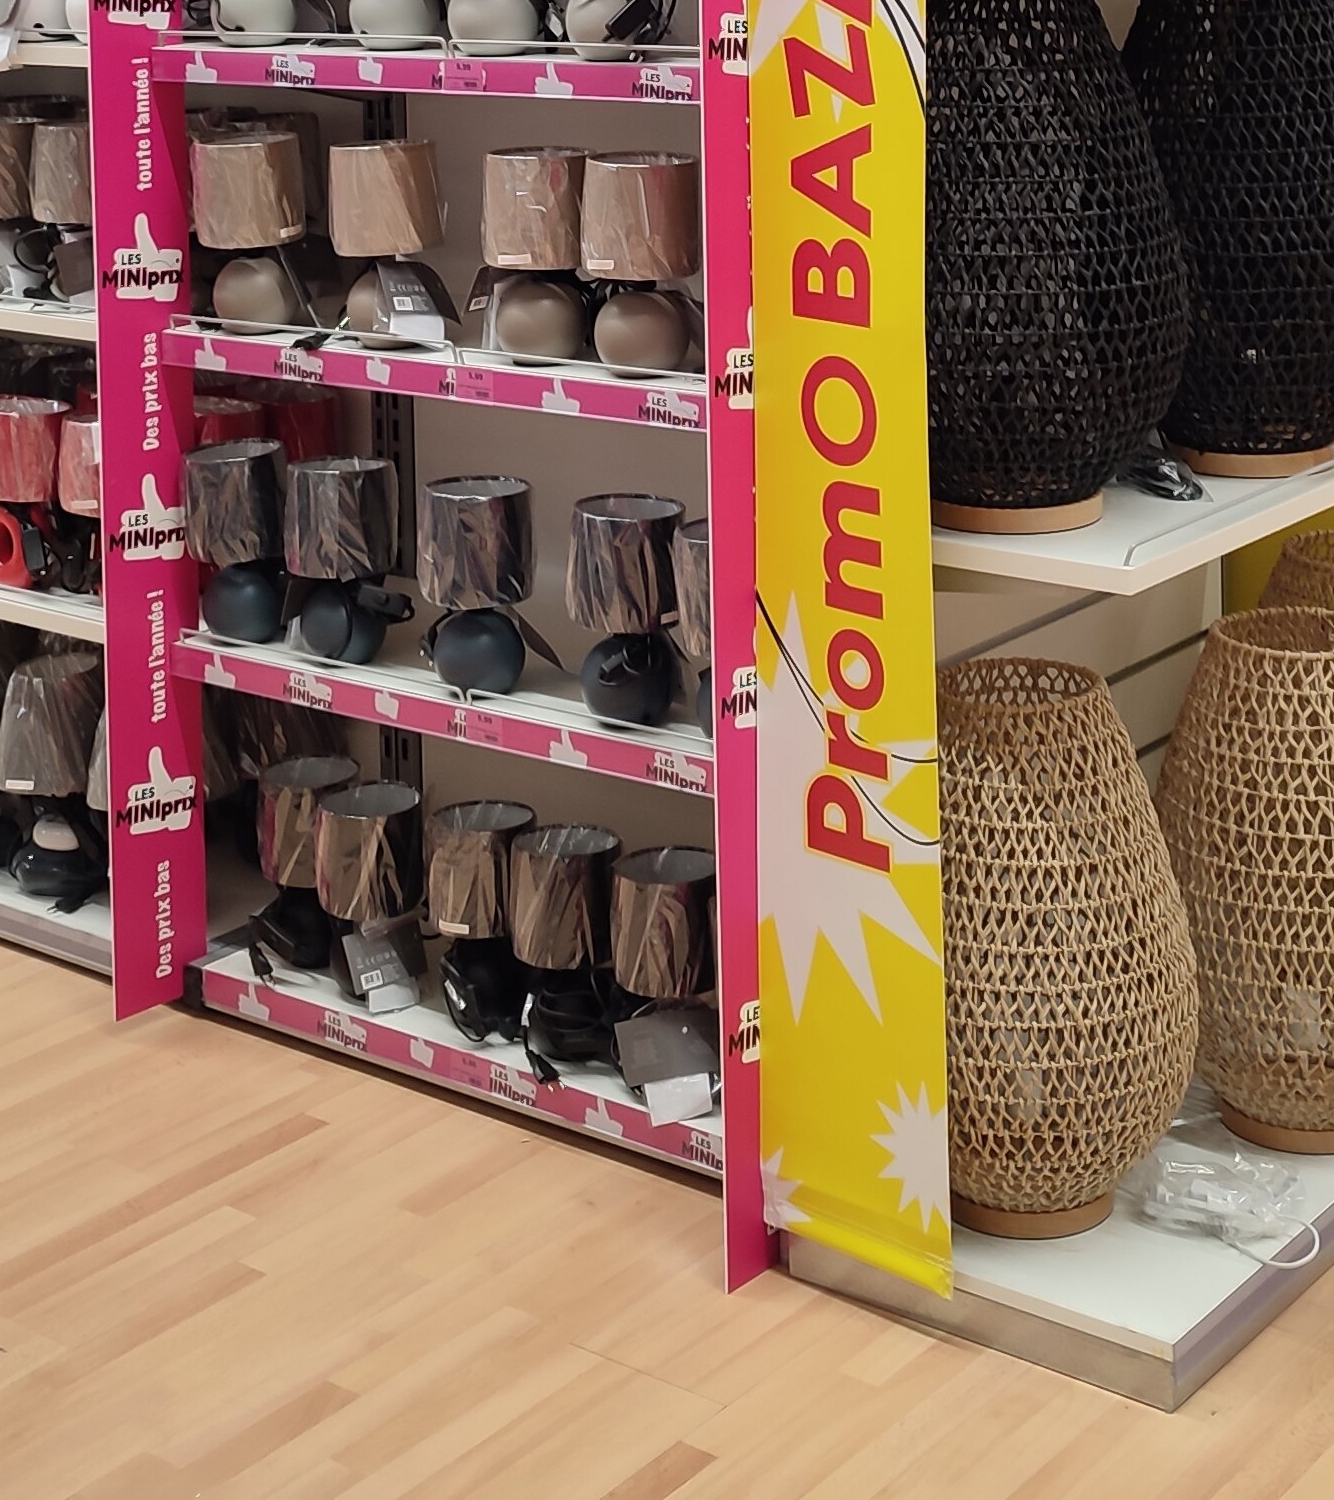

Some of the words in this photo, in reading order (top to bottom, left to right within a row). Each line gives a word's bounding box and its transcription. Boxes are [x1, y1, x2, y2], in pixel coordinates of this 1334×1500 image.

[136, 136, 153, 191] toute
[121, 252, 142, 266] LES
[141, 332, 157, 366] bas
[141, 370, 163, 414] prix
[143, 417, 160, 451] Des
[128, 513, 149, 528] LES
[150, 673, 167, 723] toute
[134, 785, 156, 802] LES
[152, 860, 170, 894] bas
[154, 896, 177, 935] prix
[155, 937, 175, 980] Des
[744, 1005, 761, 1025] LE
